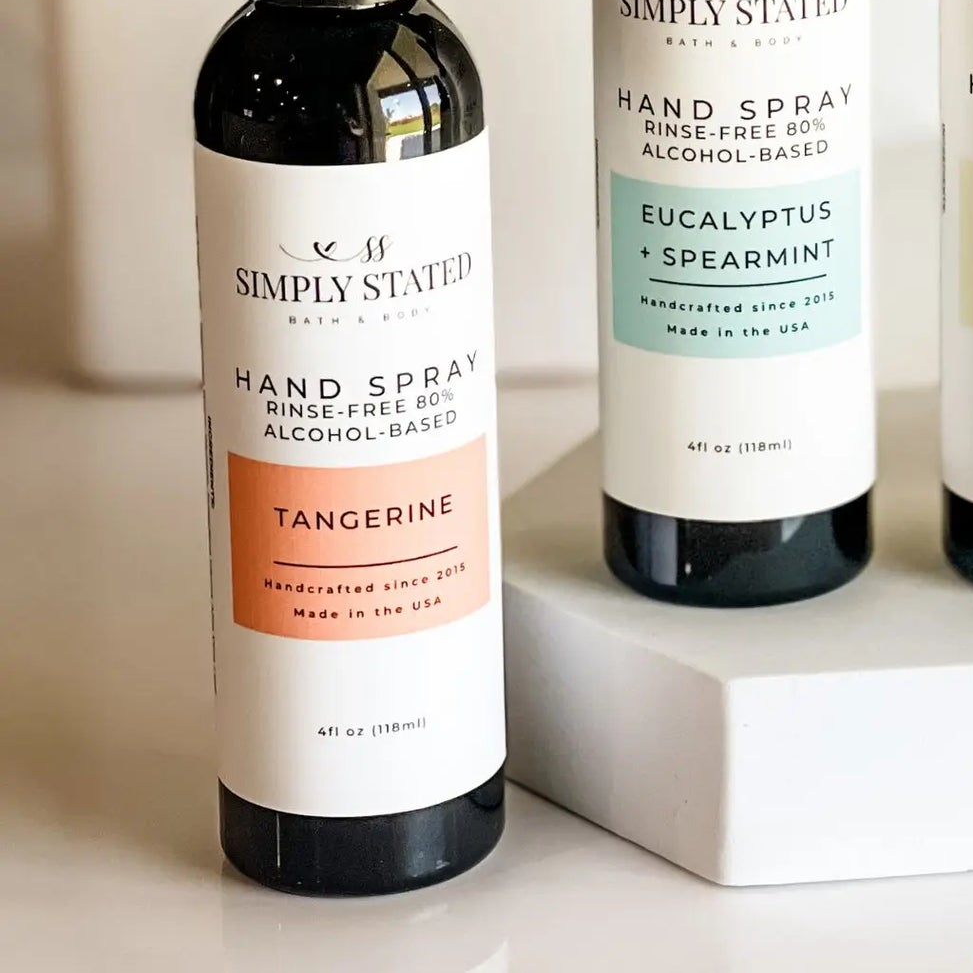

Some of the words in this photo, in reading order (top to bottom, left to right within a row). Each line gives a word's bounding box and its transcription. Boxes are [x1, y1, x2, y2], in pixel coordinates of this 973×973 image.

[666, 37, 713, 48] BATH
[731, 40, 738, 48] &
[755, 35, 803, 47] BODY
[618, 87, 713, 120] HAND
[740, 83, 852, 121] SPRAY
[645, 120, 777, 140] RINSE-FREE
[786, 118, 826, 136] 80%
[642, 139, 829, 163] ALCOHOL-BASED
[642, 201, 832, 231] EUCALYPTUS
[640, 246, 650, 259] +
[663, 238, 835, 270] SPEARMINT
[235, 267, 353, 303] SIMPLY
[363, 251, 472, 301] STATED
[640, 295, 742, 313] Handcrafted
[752, 300, 796, 313] since
[804, 291, 835, 307] 2015
[289, 315, 339, 325] BATH
[358, 316, 365, 324] &
[383, 307, 431, 322] BODY
[667, 324, 708, 337] Made
[718, 327, 733, 337] in
[743, 326, 770, 337] the
[779, 321, 809, 334] USA
[235, 367, 341, 399] HAND
[369, 350, 478, 397] SPRAY
[266, 400, 406, 419] RINSE-FREE
[416, 388, 454, 409] 80%
[264, 410, 457, 442] ALCOHOL-BASED
[687, 441, 707, 453] 4fl
[714, 443, 731, 453] oz
[738, 439, 792, 454] (118ml)
[273, 494, 453, 530] TANGERINE
[264, 578, 374, 594] Handcrafted
[384, 576, 429, 591] since
[437, 563, 466, 581] 2015
[294, 607, 338, 619] Made
[349, 608, 364, 619] in
[375, 604, 403, 616] the
[412, 596, 442, 611] USA
[317, 726, 338, 737] 4fl
[346, 727, 364, 737] oz
[372, 717, 426, 737] (118ml)
